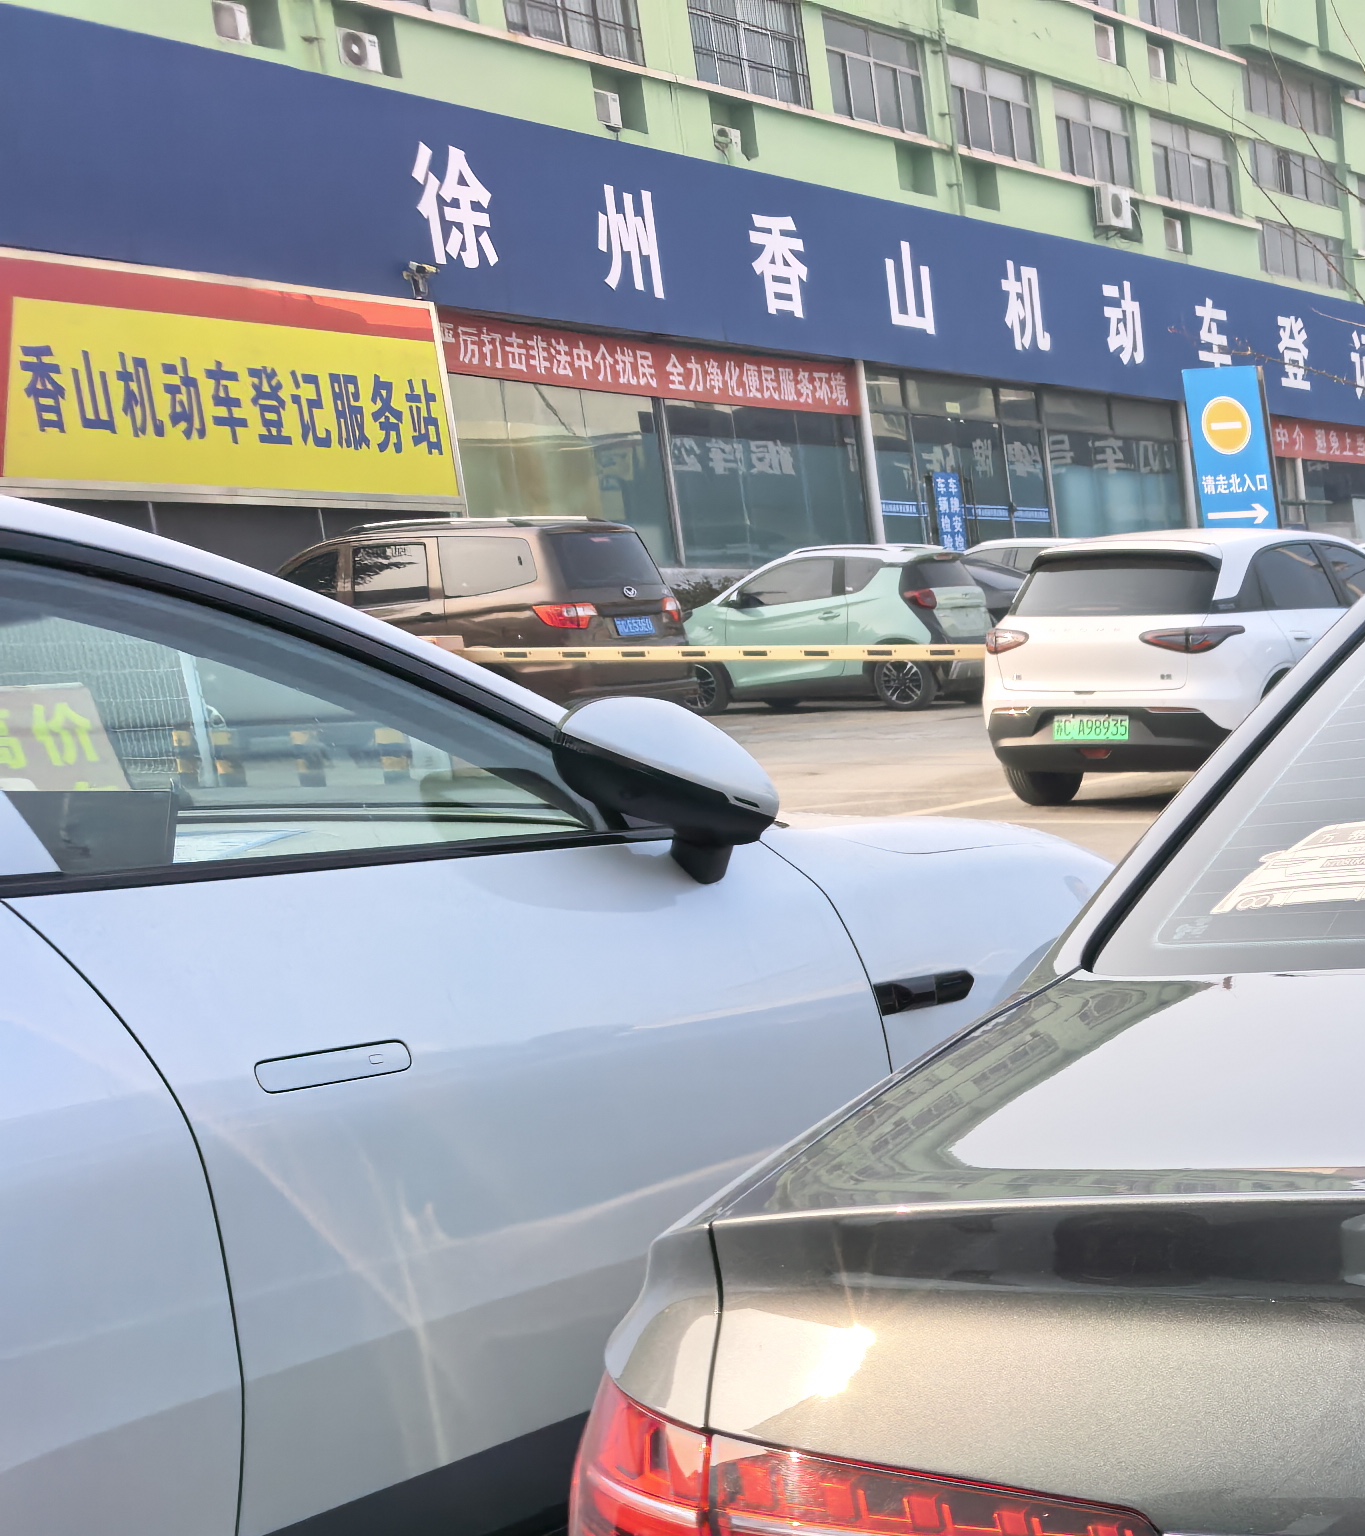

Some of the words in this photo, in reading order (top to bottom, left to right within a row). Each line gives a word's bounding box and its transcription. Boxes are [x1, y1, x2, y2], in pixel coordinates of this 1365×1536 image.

[19, 344, 444, 456] 香山机动车登记服务站
[1202, 473, 1268, 495] 请走北入口
